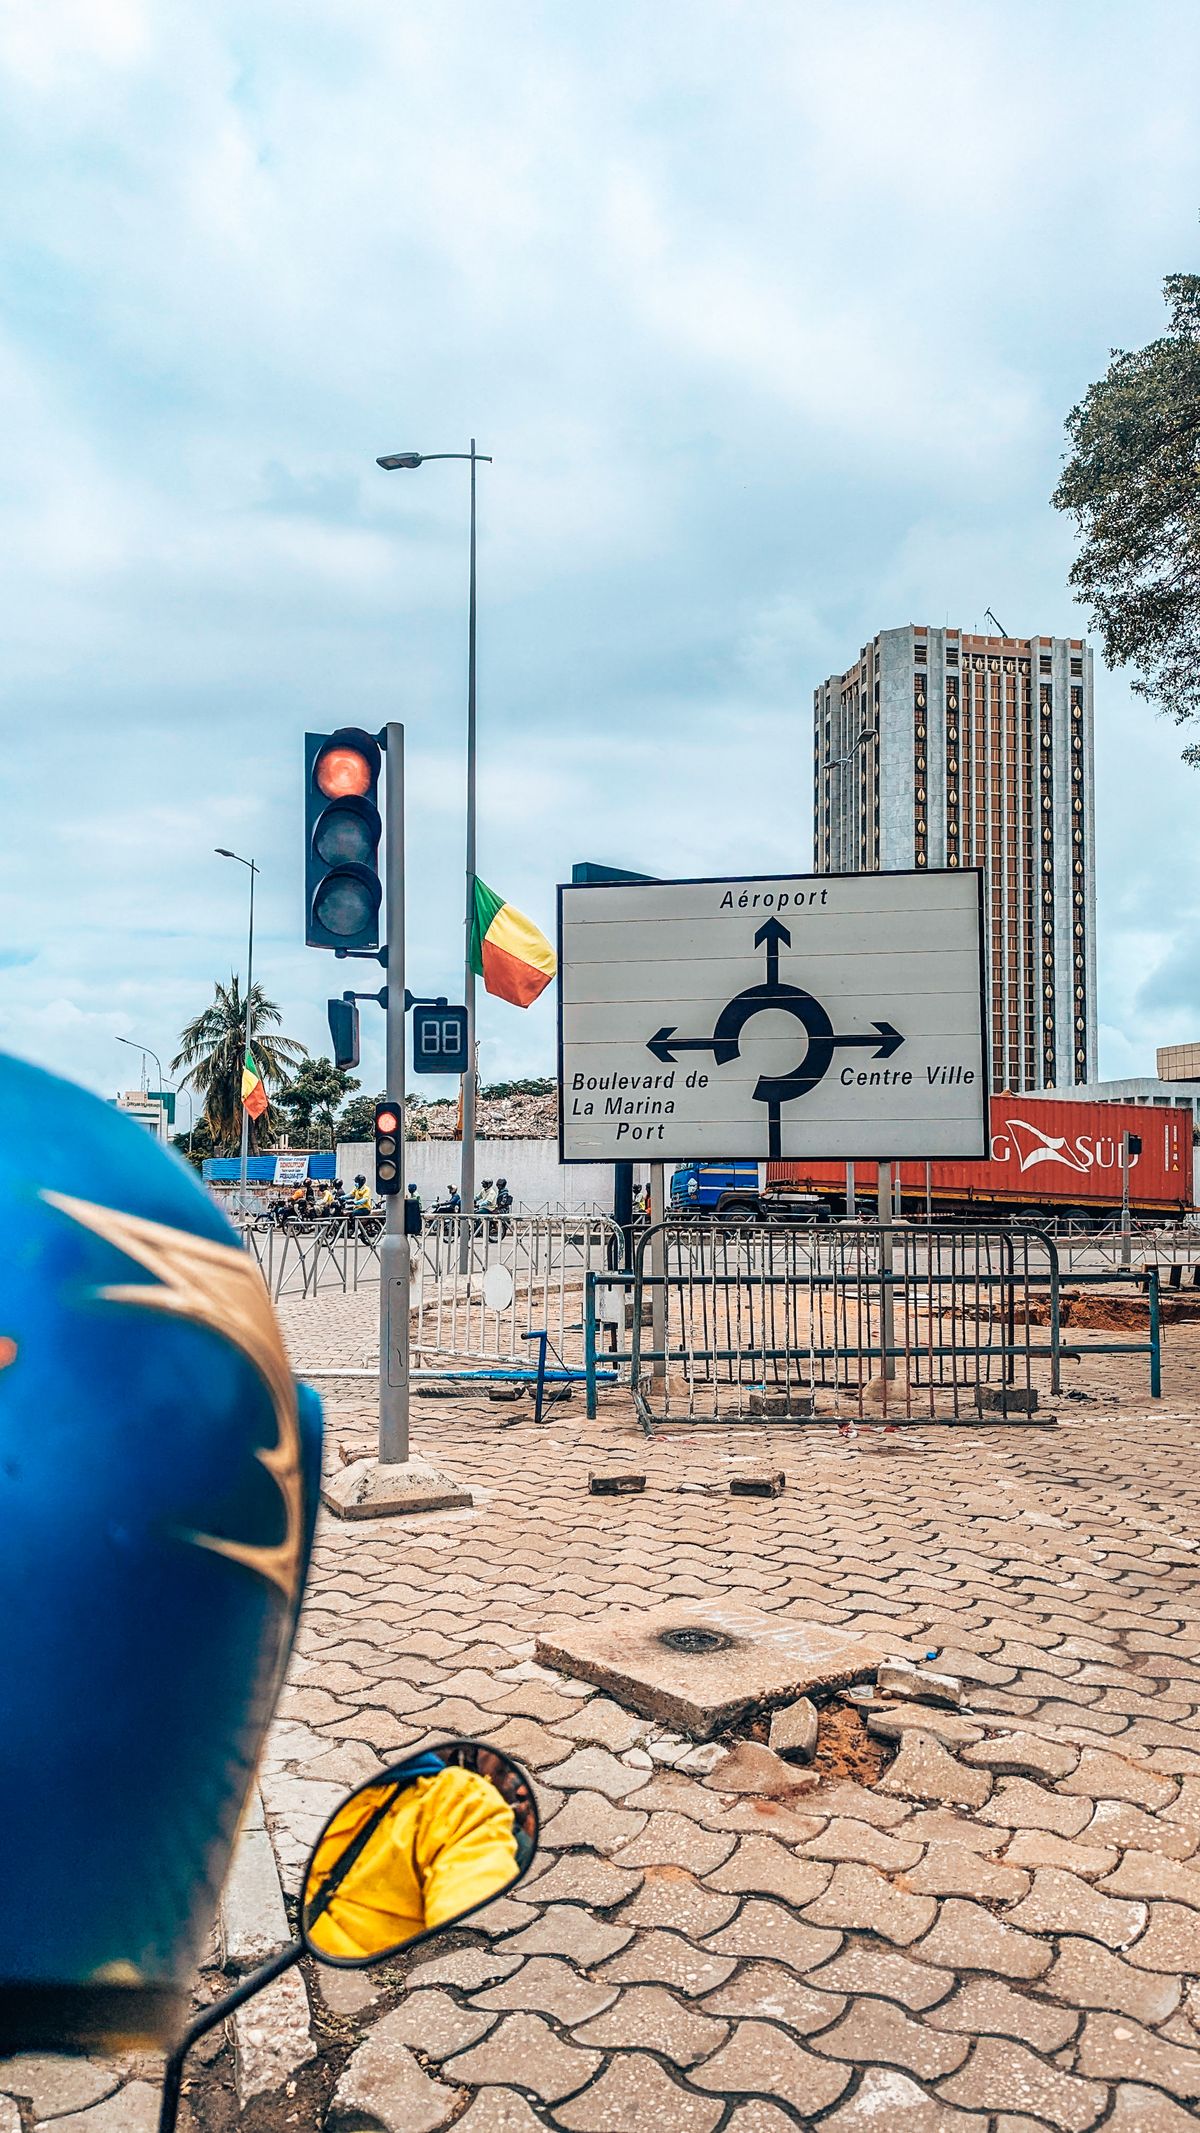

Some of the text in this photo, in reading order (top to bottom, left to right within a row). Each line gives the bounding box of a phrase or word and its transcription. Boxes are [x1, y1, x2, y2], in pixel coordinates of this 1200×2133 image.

[719, 888, 829, 911] Aéroport
[572, 1070, 709, 1091] Boulevard de
[840, 1065, 975, 1087] Centre Ville
[572, 1096, 675, 1116] La Marina
[616, 1122, 665, 1141] Port
